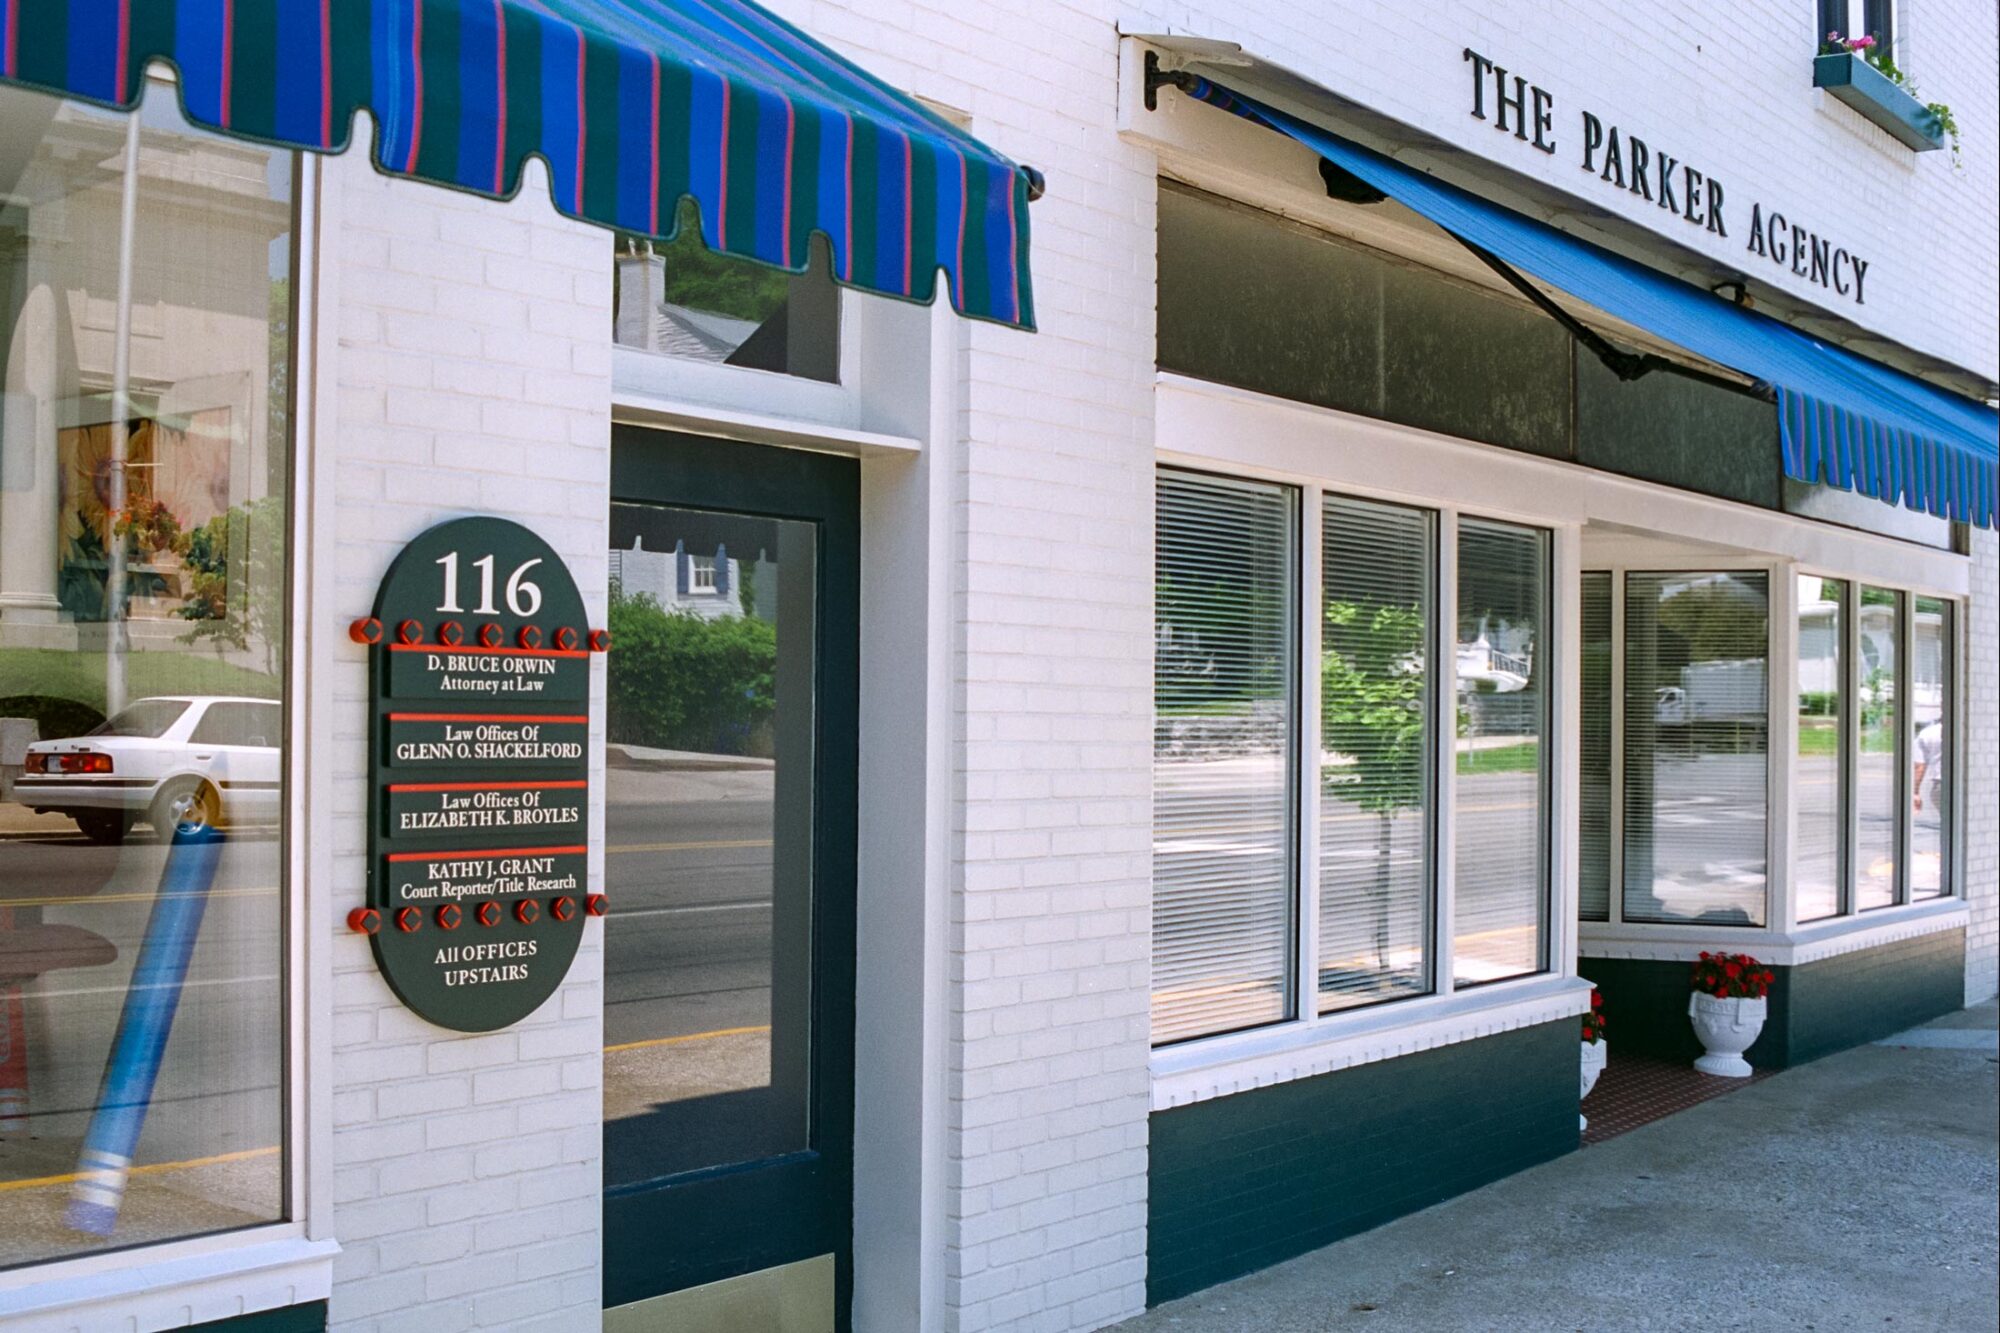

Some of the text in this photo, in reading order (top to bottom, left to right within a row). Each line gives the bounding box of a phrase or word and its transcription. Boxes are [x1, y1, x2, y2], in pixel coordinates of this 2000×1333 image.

[1463, 47, 1869, 305] THE PARKER AGENCY
[435, 551, 543, 618] 116
[427, 654, 556, 675] D. BRUCE ORWIN
[440, 674, 545, 695] Attorney at Law
[445, 724, 540, 742] Law Offices Of
[396, 742, 582, 760] GLENN O. SHACKELFORD
[441, 791, 541, 810] Law Offices Of
[400, 807, 579, 830] ELIZABETH K. BROYLES
[428, 858, 555, 880] KATHY J. GRANT
[400, 873, 577, 901] Court Reporter/Title Research
[461, 939, 538, 962] OFFICES
[444, 963, 529, 986] UPSTAIRS
